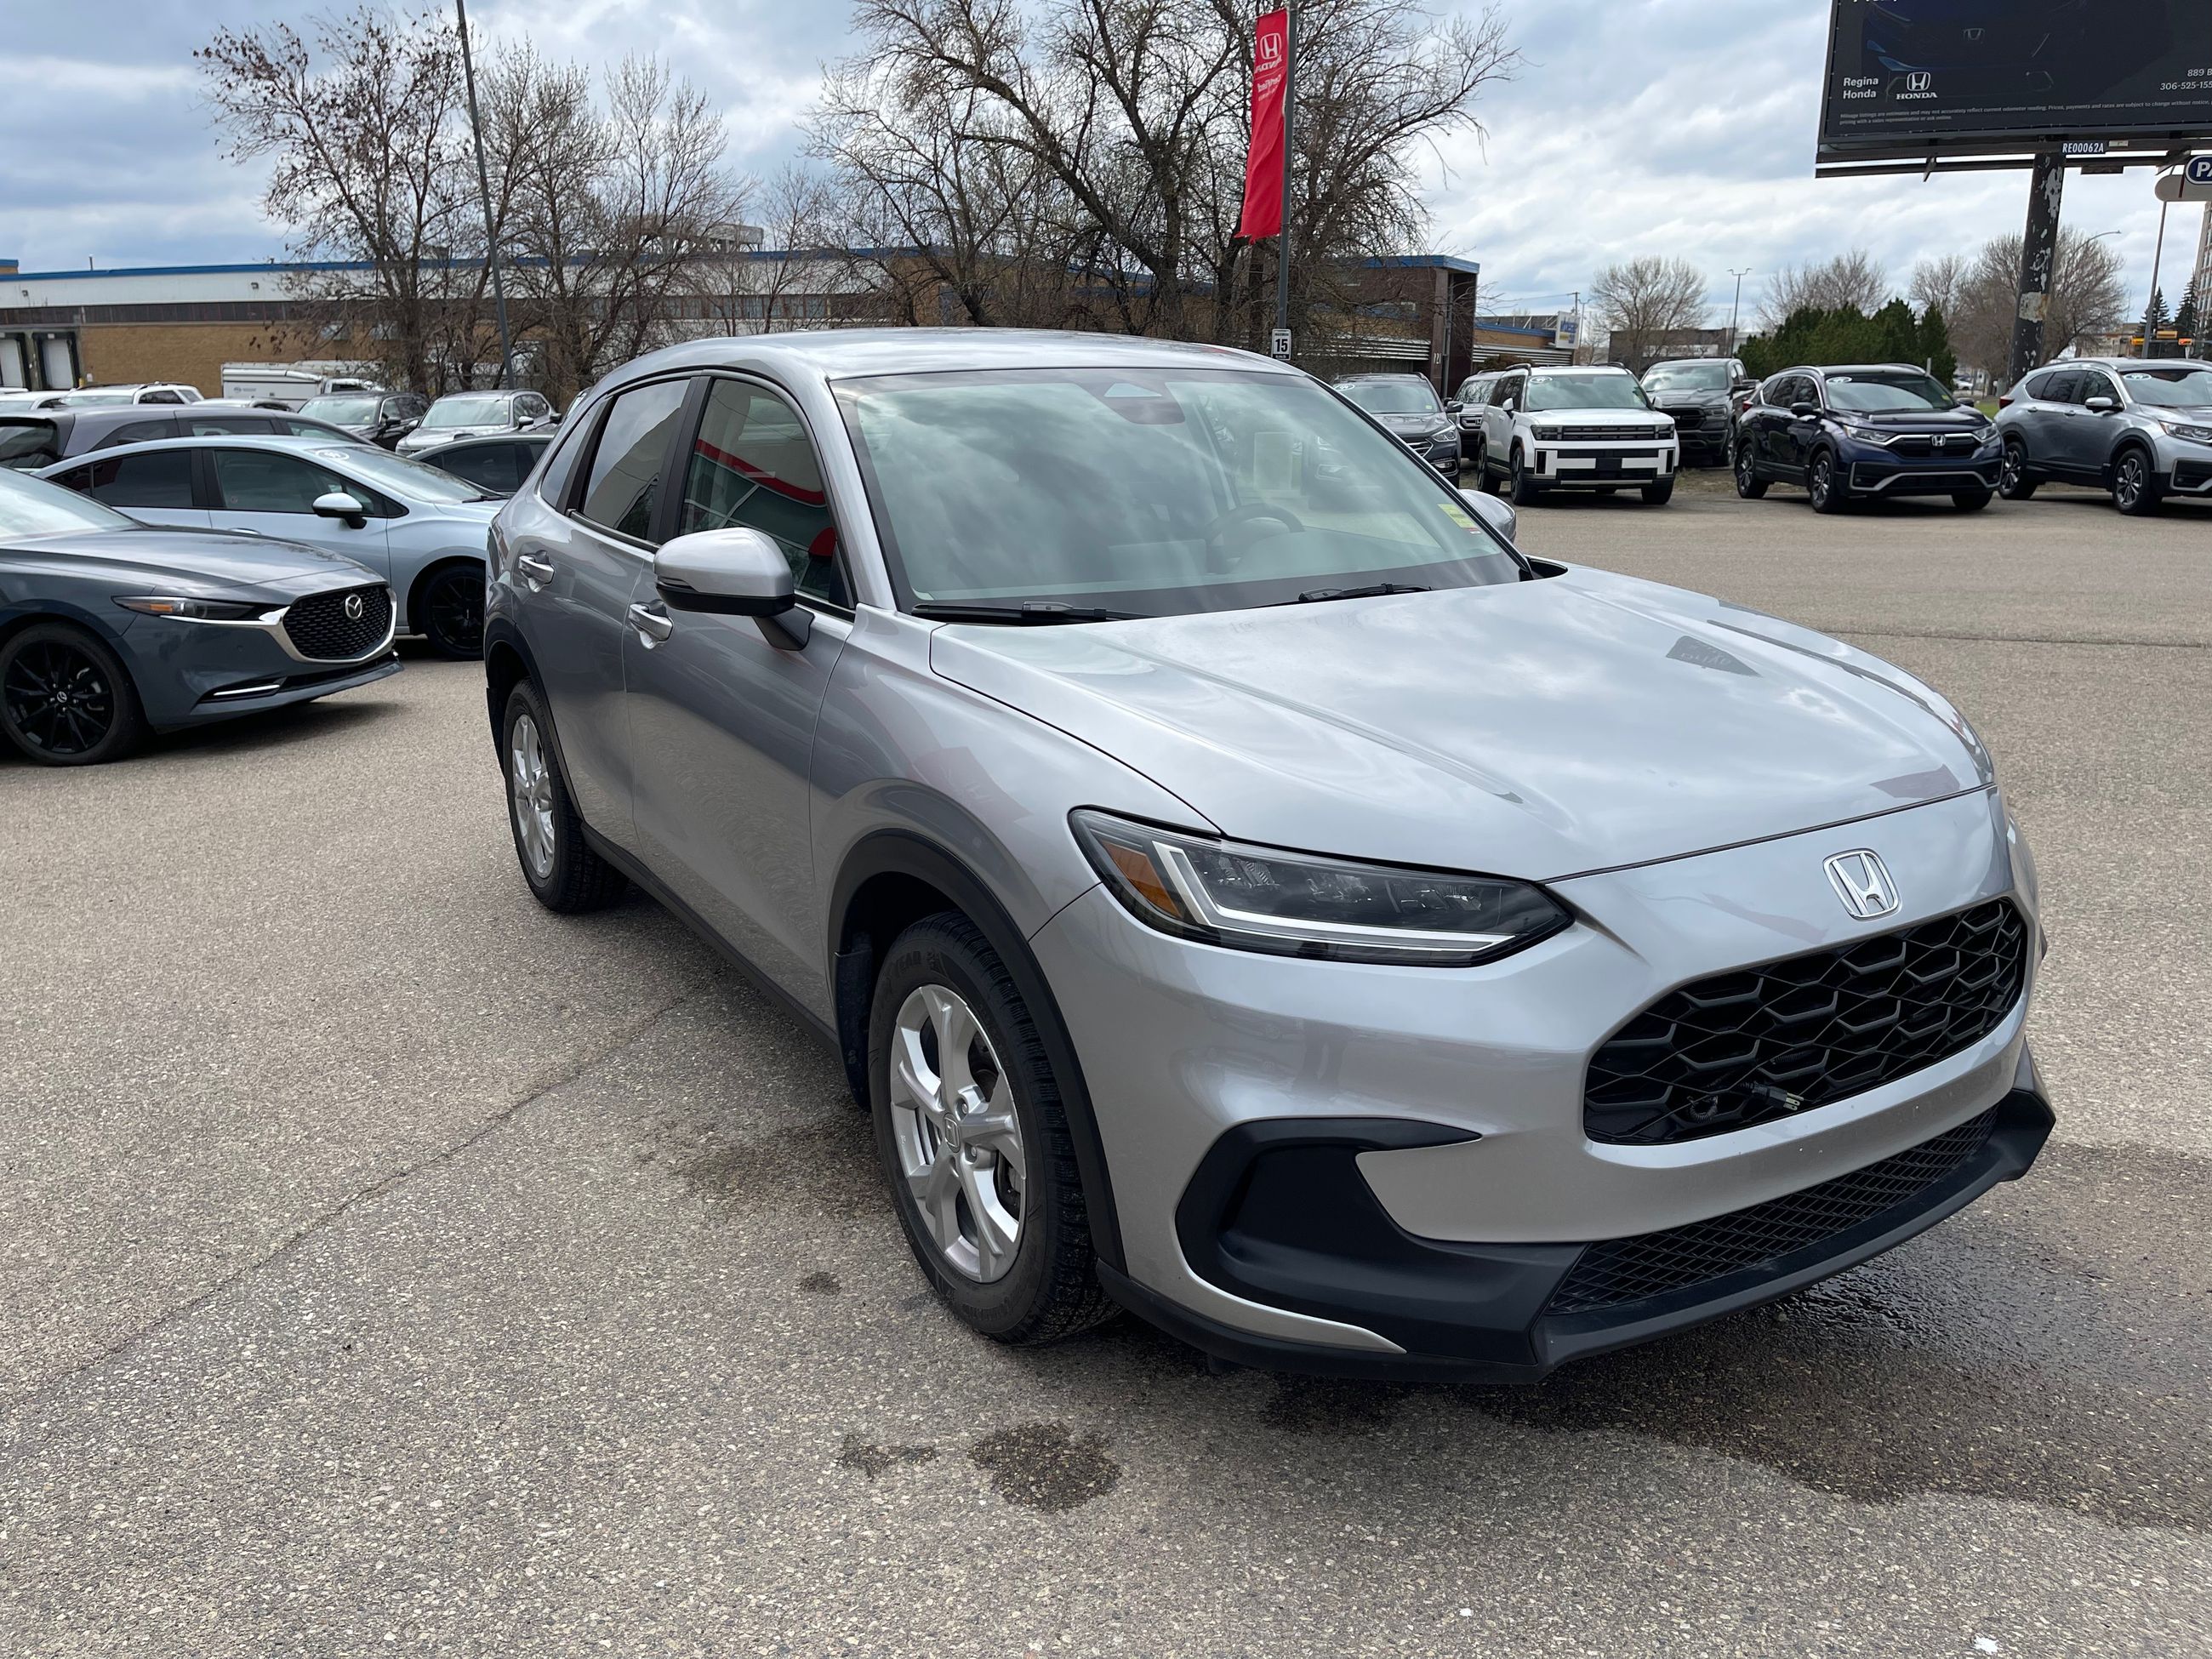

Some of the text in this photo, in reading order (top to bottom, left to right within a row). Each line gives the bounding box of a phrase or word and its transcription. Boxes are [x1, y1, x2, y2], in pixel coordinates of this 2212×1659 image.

[2187, 69, 2204, 77] 889
[1843, 77, 1879, 88] Regina
[1843, 89, 1877, 100] Honda
[1896, 92, 1938, 100] HONDA
[2062, 141, 2104, 153] RE00062A
[1275, 339, 1288, 352] 15
